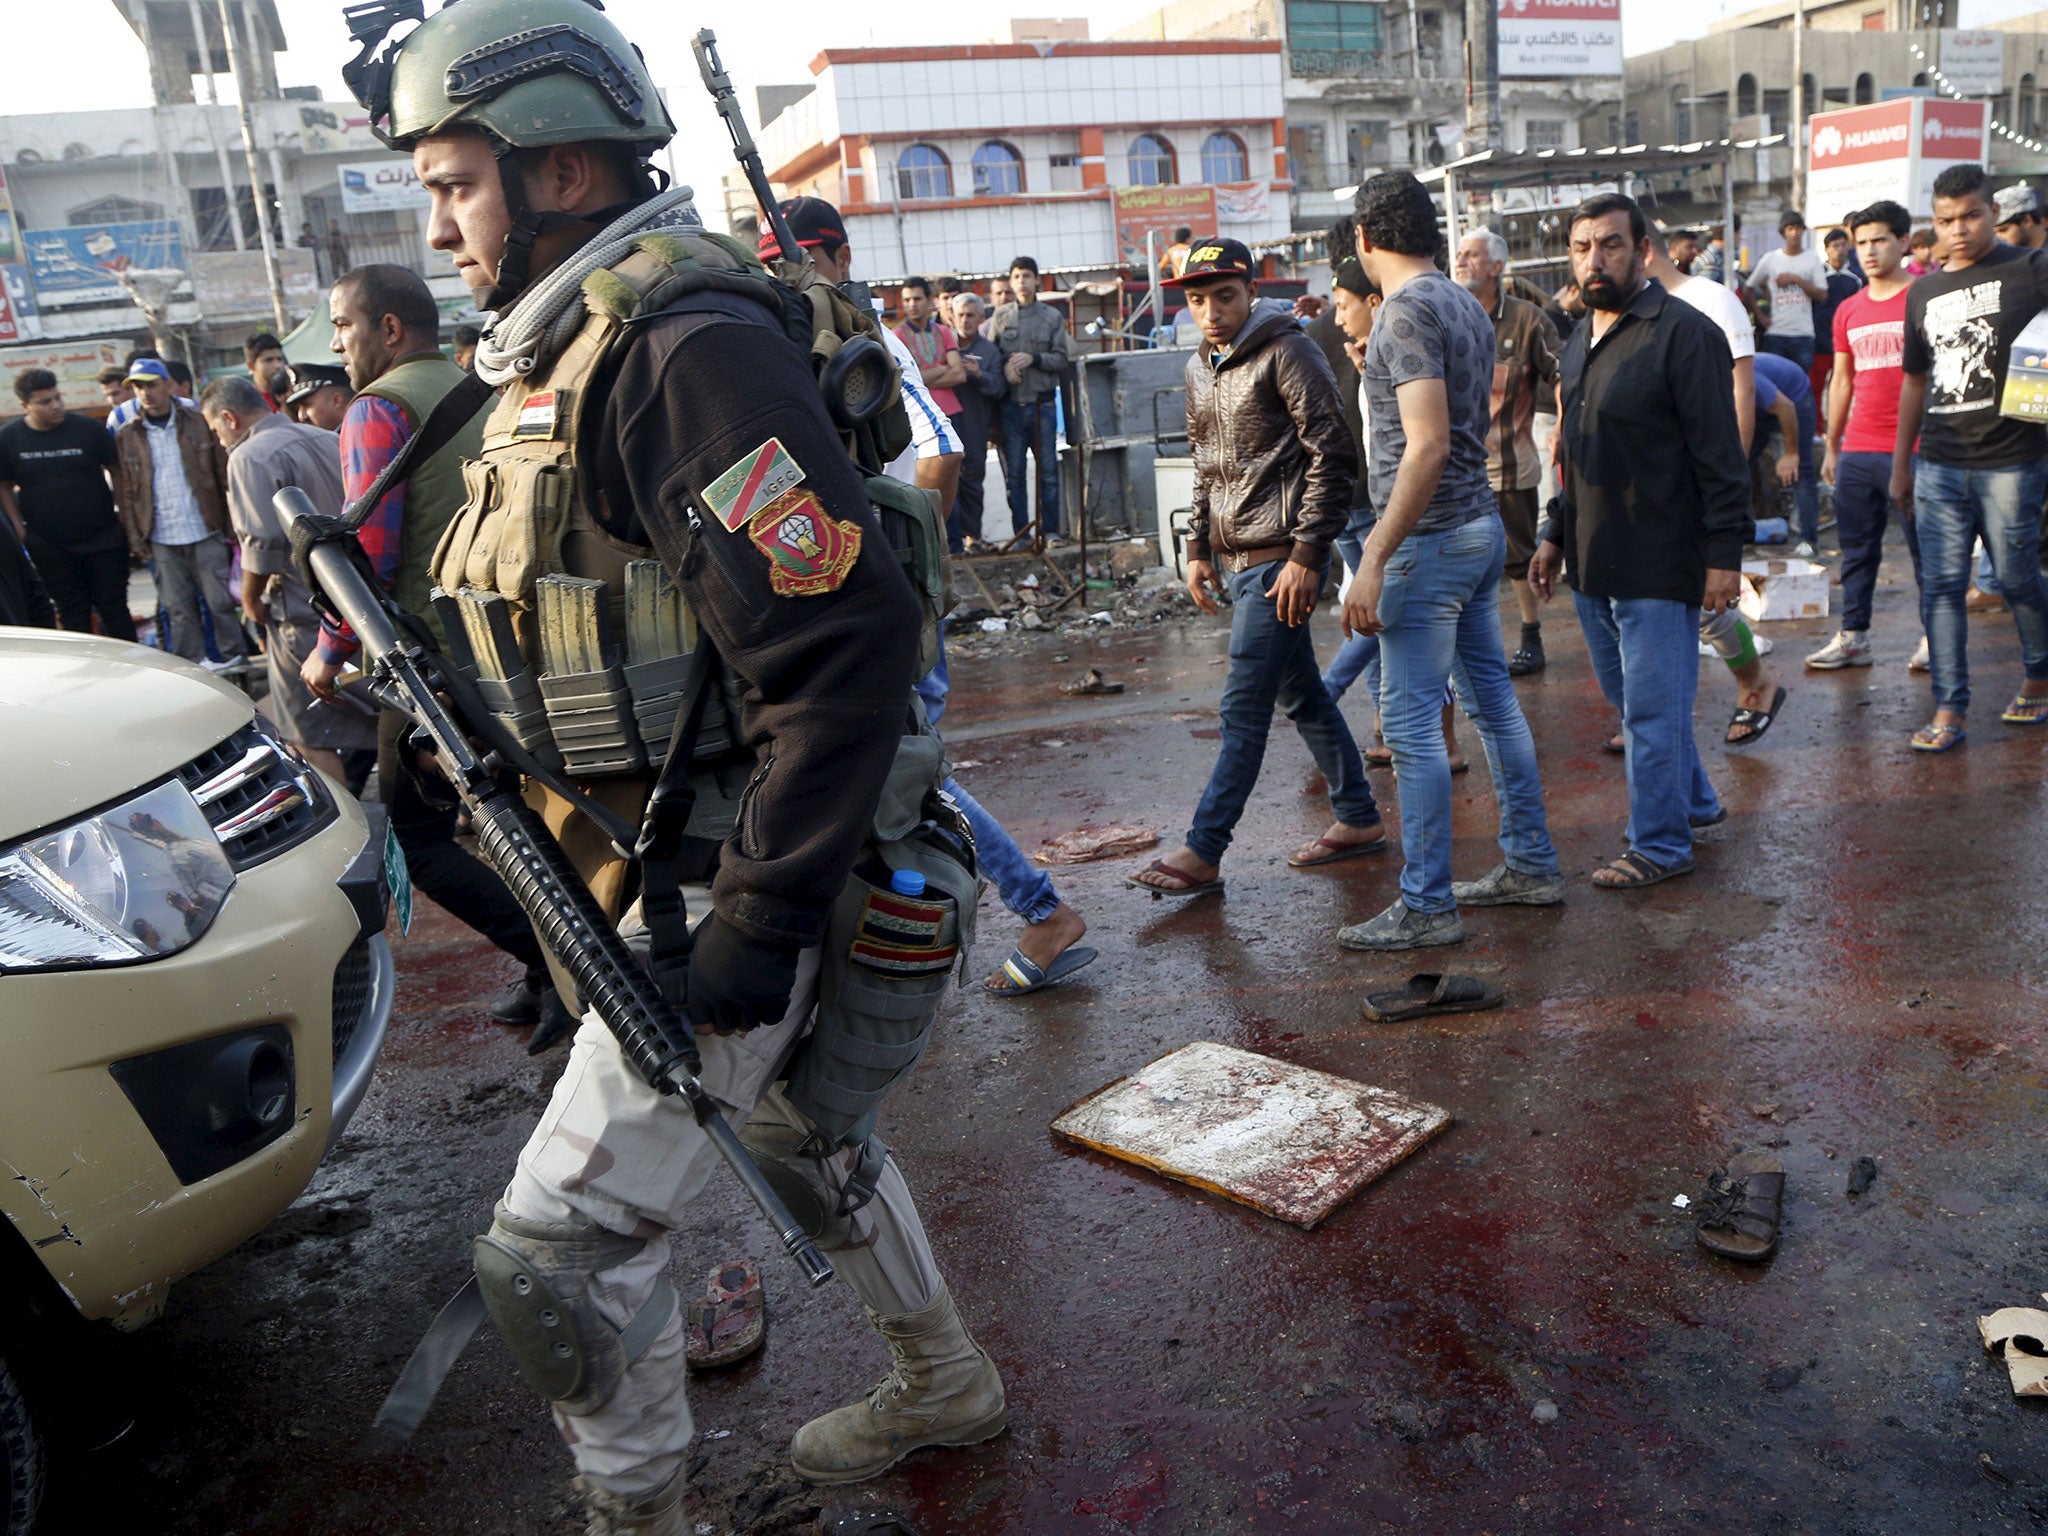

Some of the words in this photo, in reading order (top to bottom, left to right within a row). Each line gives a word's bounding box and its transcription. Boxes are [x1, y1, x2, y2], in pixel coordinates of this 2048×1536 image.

[1845, 124, 1907, 149] HUAWEI
[1190, 246, 1224, 264] 46
[762, 470, 797, 498] IGFC
